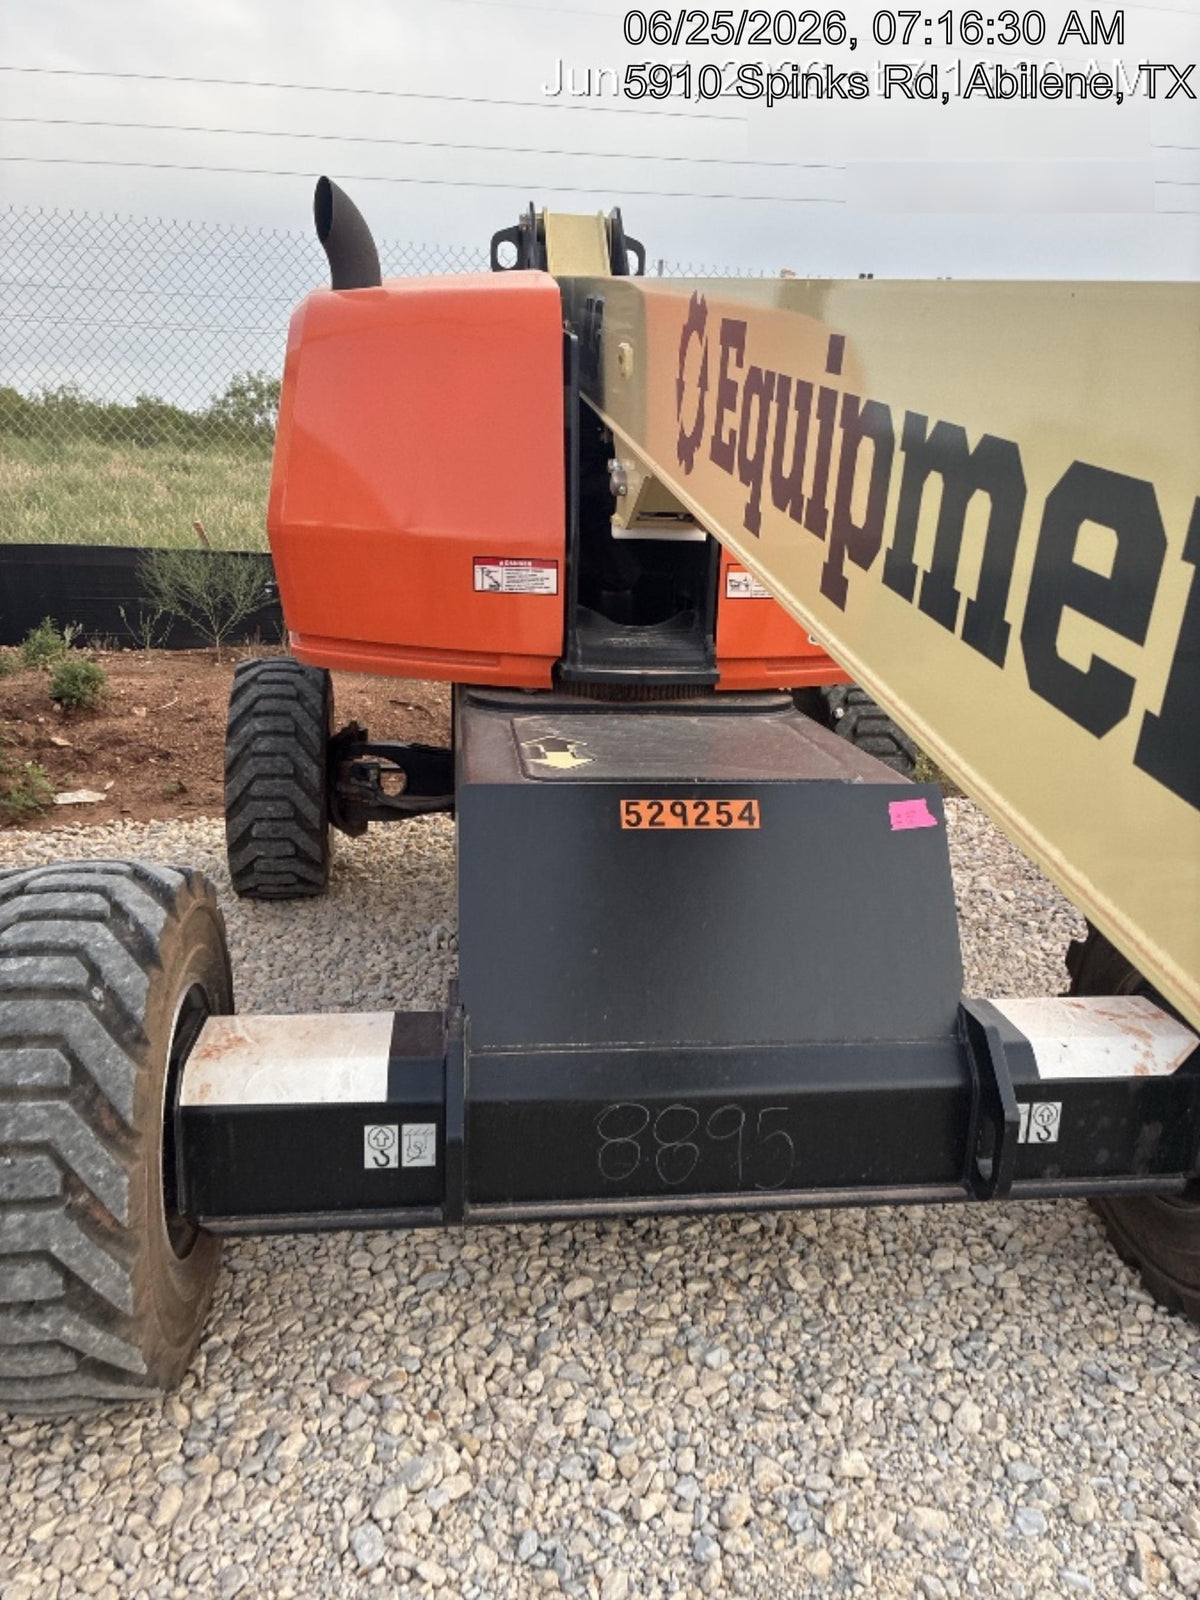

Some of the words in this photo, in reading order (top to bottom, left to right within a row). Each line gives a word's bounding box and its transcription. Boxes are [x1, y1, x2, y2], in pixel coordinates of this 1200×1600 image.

[710, 317, 1200, 813] Equipme
[625, 801, 756, 827] 529254
[594, 1102, 795, 1190] 8895
